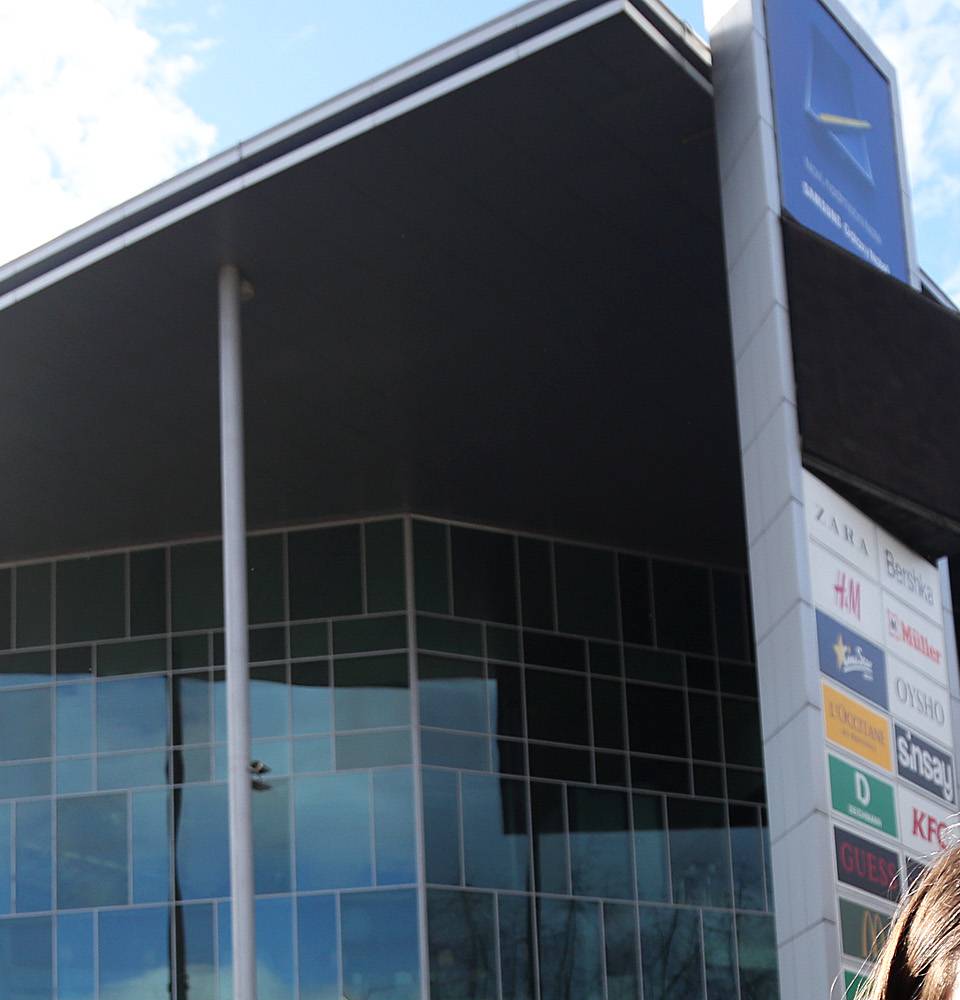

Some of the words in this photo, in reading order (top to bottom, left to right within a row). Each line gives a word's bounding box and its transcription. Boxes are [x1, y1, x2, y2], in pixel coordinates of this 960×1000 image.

[815, 503, 870, 557] ZARA
[884, 548, 934, 607] Bershka
[900, 619, 942, 666] Müller
[896, 675, 945, 726] OYSHO
[854, 770, 871, 806] D
[897, 729, 954, 802] sinsay
[838, 841, 898, 892] GUESS
